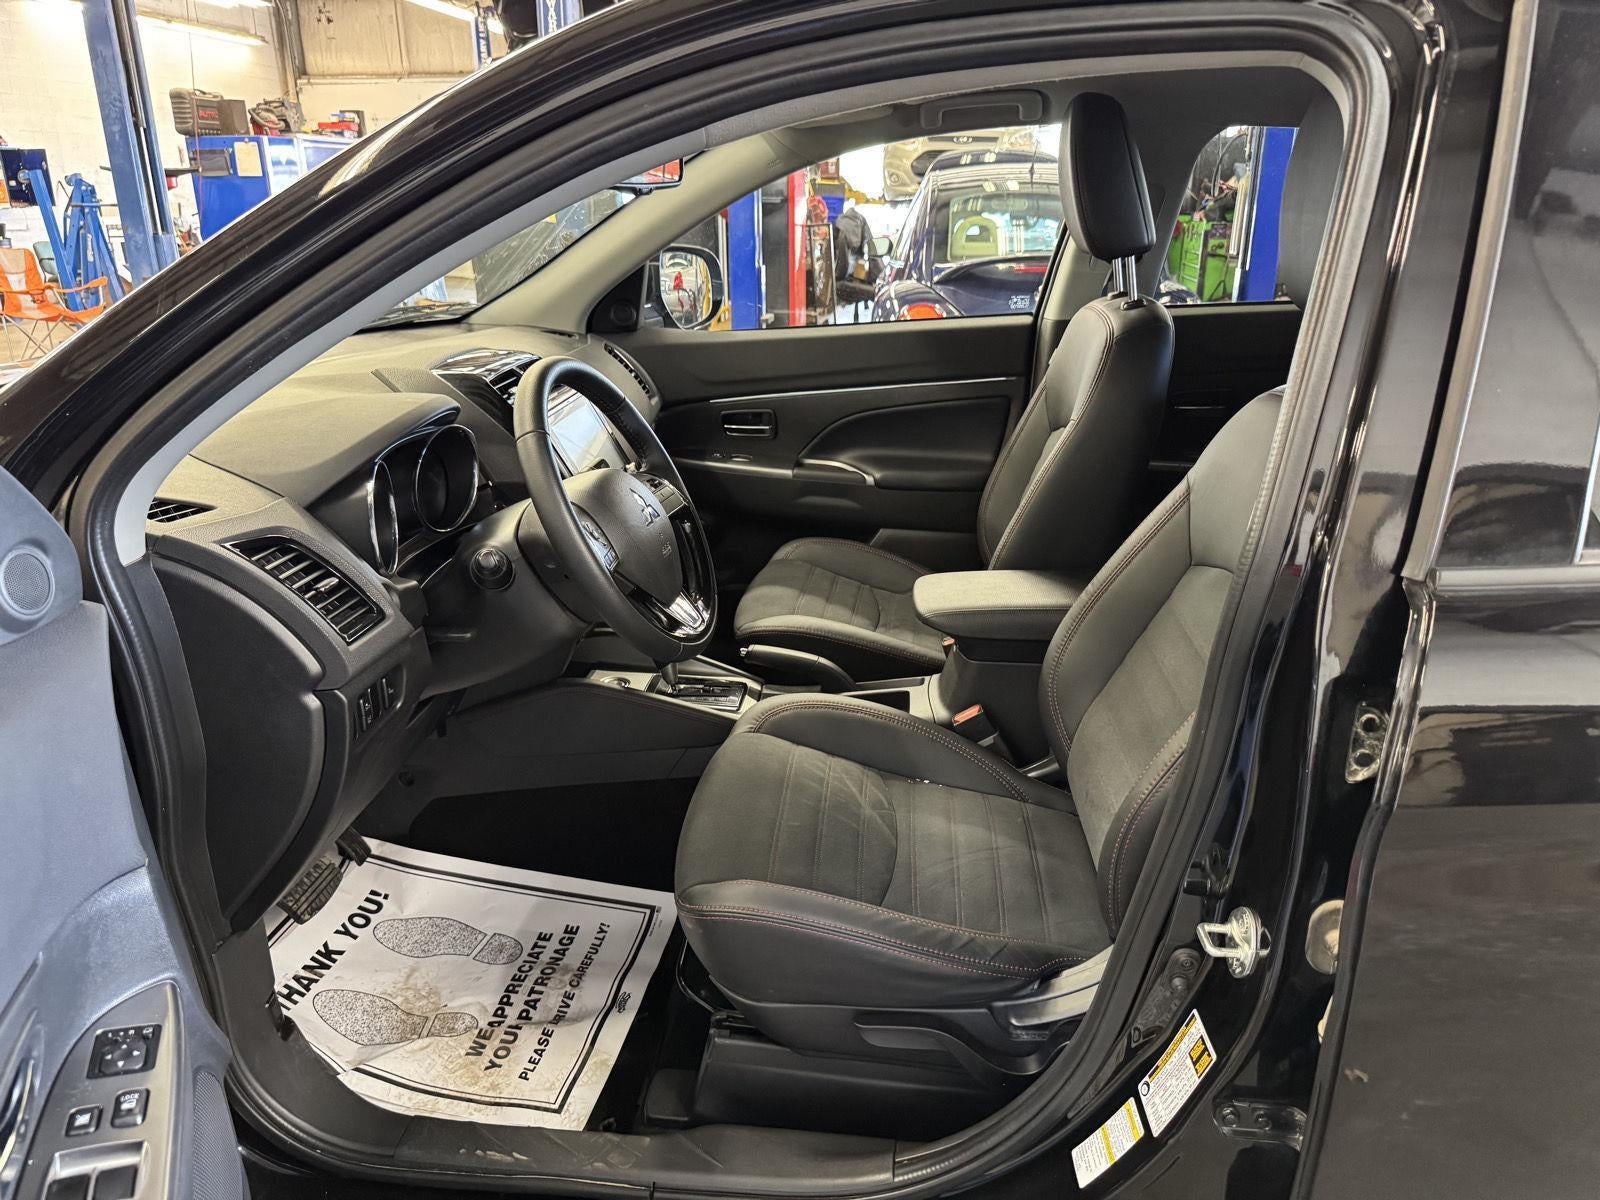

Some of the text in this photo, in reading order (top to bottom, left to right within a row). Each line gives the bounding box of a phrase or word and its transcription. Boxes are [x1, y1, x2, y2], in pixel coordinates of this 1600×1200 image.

[333, 889, 390, 941] YOU!
[465, 932, 553, 1057] WE APPRECIATE
[517, 924, 580, 1021] PATRONAGE
[518, 1026, 554, 1081] PLEASE
[568, 922, 611, 988] CAREFULLY!
[121, 1093, 140, 1101] LOCK
